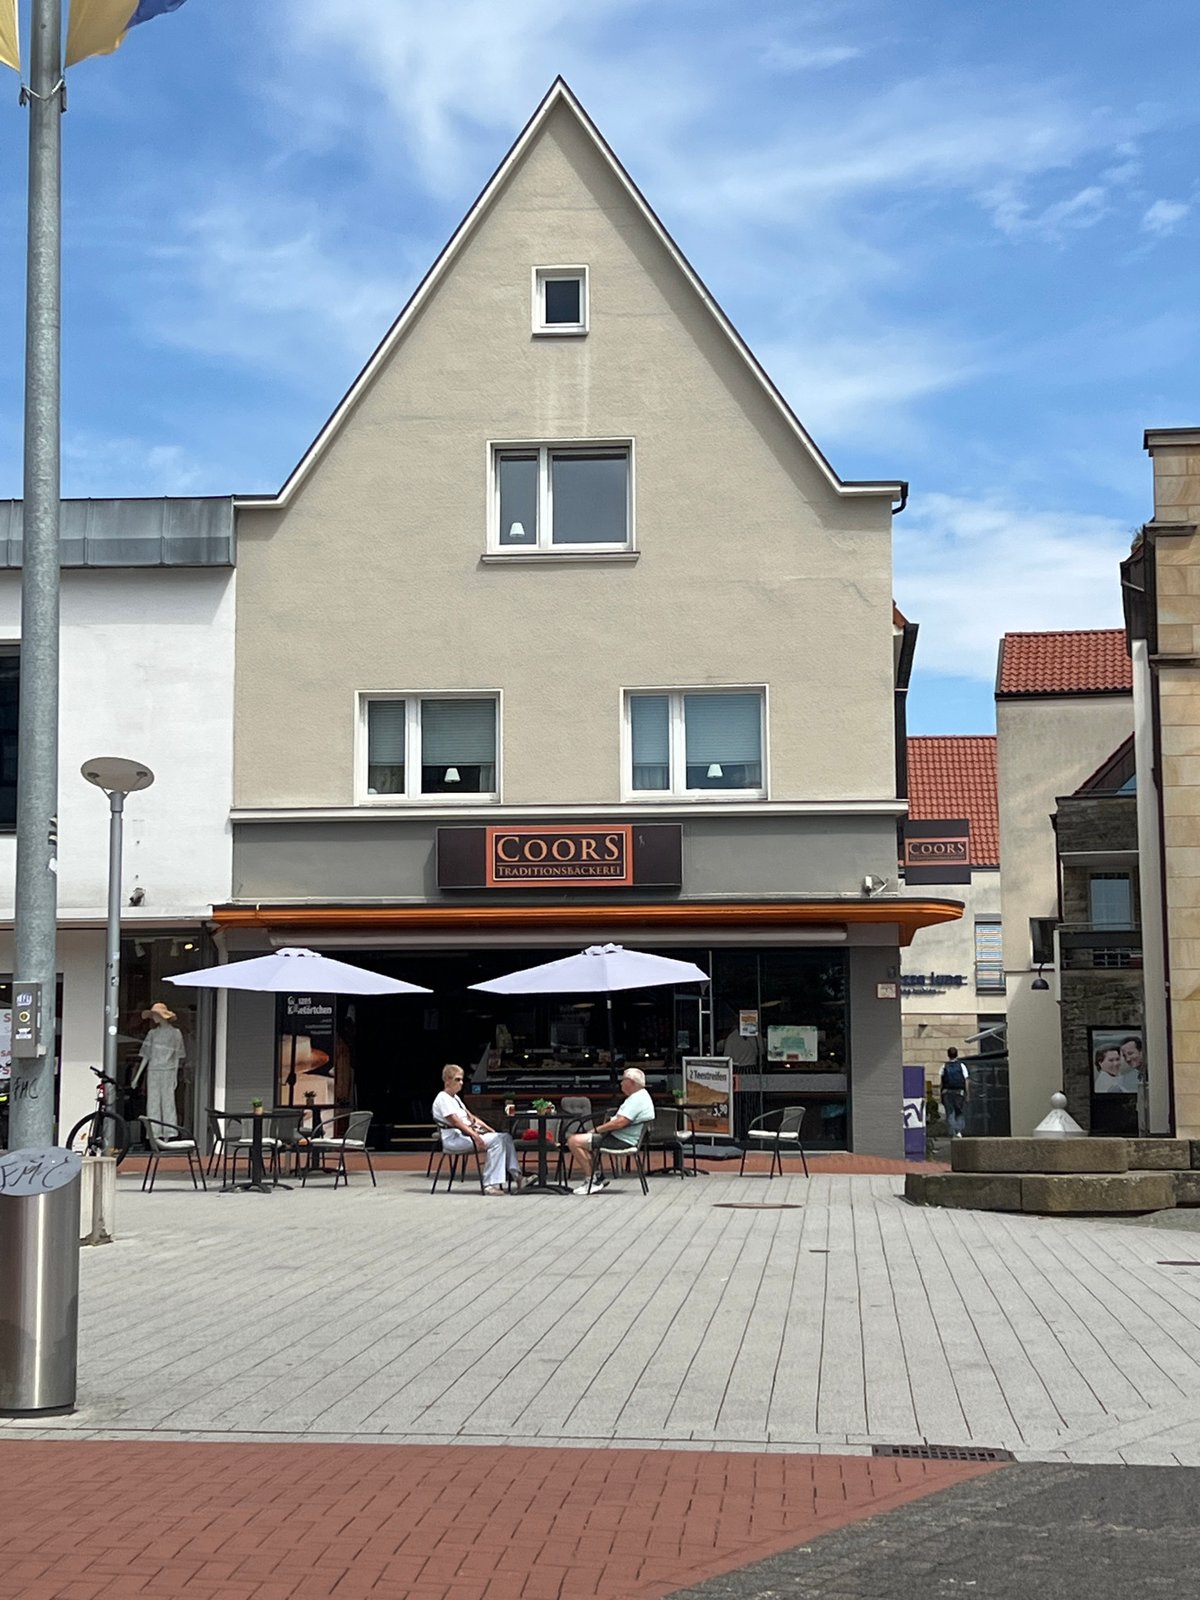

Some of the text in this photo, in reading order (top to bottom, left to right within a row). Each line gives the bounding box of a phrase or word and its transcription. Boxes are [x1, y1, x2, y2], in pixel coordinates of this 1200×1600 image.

[497, 835, 619, 862] COORS
[909, 842, 965, 855] COORS
[497, 865, 620, 877] TRADITIONSBÄCKEREI
[689, 1069, 694, 1079] 2
